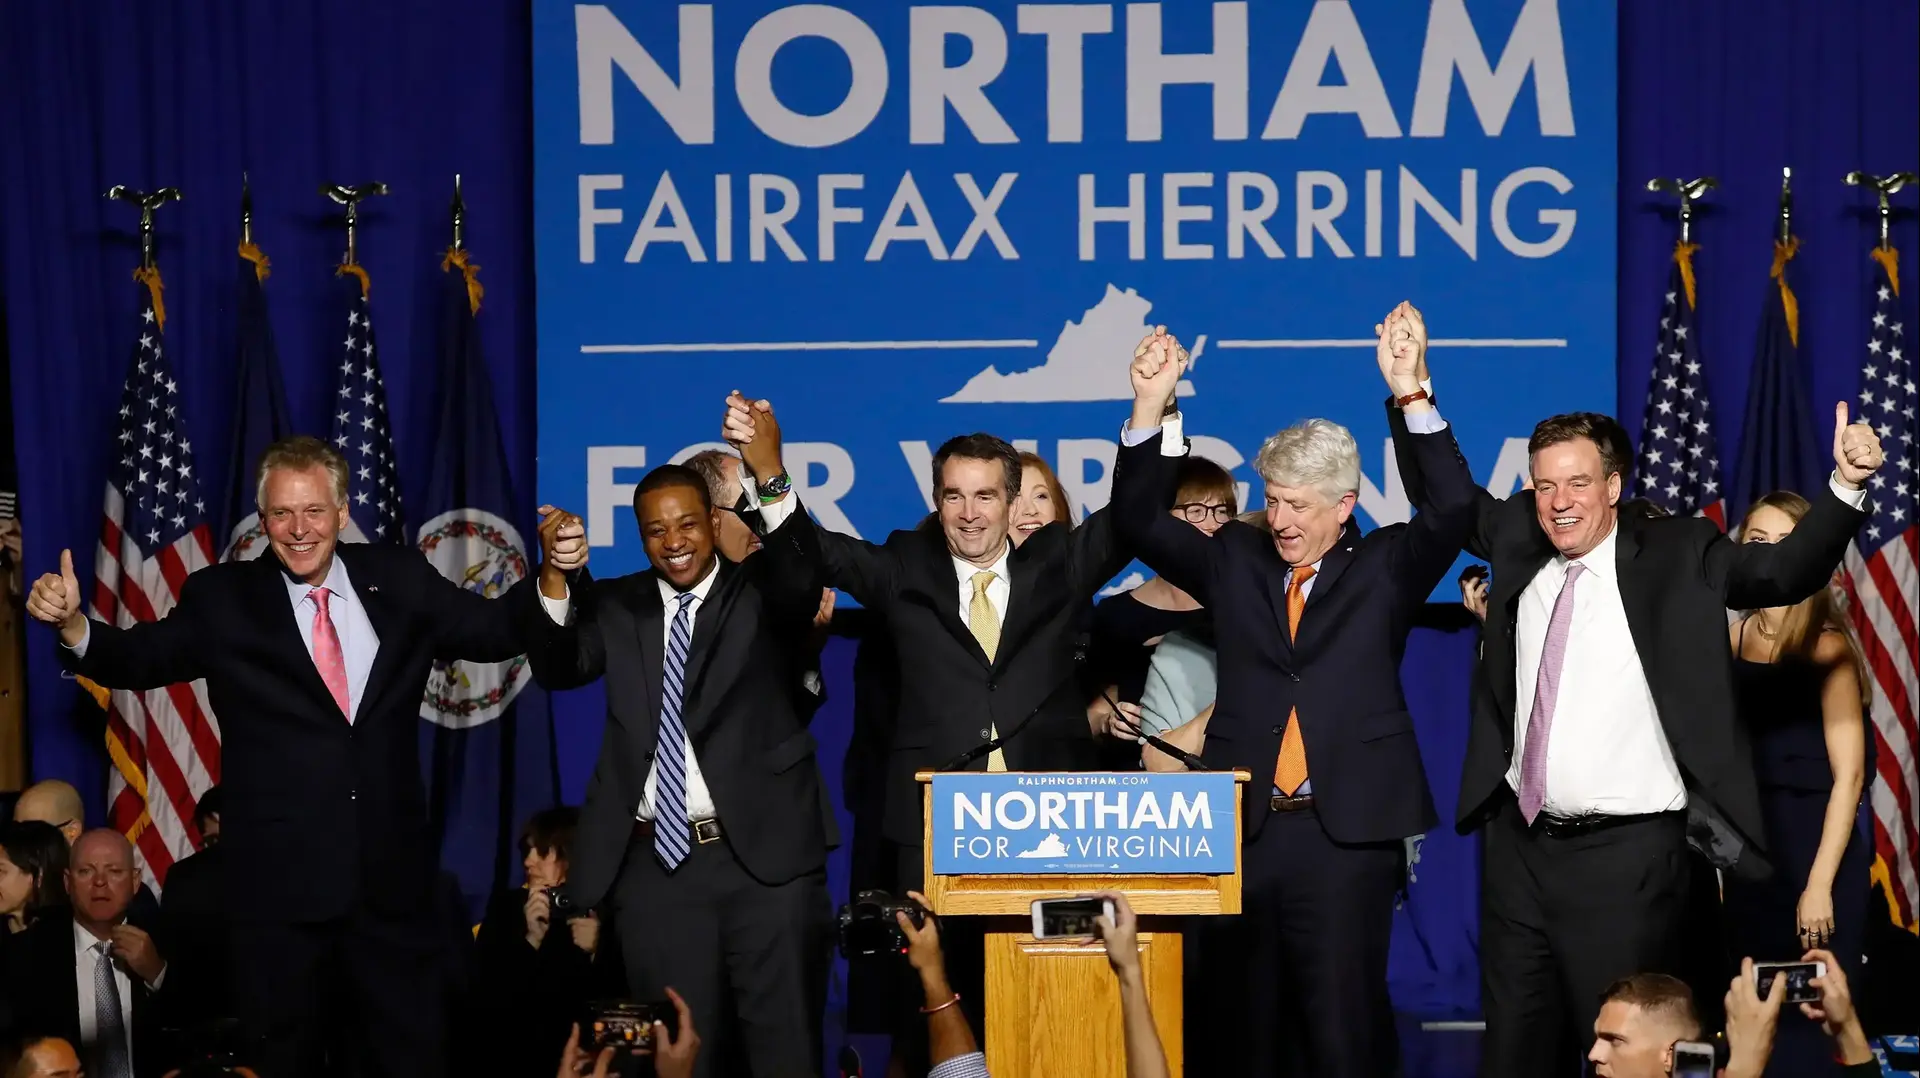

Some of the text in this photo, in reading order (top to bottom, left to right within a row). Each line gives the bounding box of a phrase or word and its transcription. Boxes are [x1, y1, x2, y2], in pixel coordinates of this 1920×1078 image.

[575, 0, 1576, 149] NORTHAM
[578, 165, 1577, 264] FAIRFAX HERRING
[586, 441, 864, 547] FR
[953, 790, 1214, 831] NORTHAM
[1017, 776, 1149, 786] RALPHNORTHAM.COM
[953, 835, 1214, 859] FOR VIRGINIA
